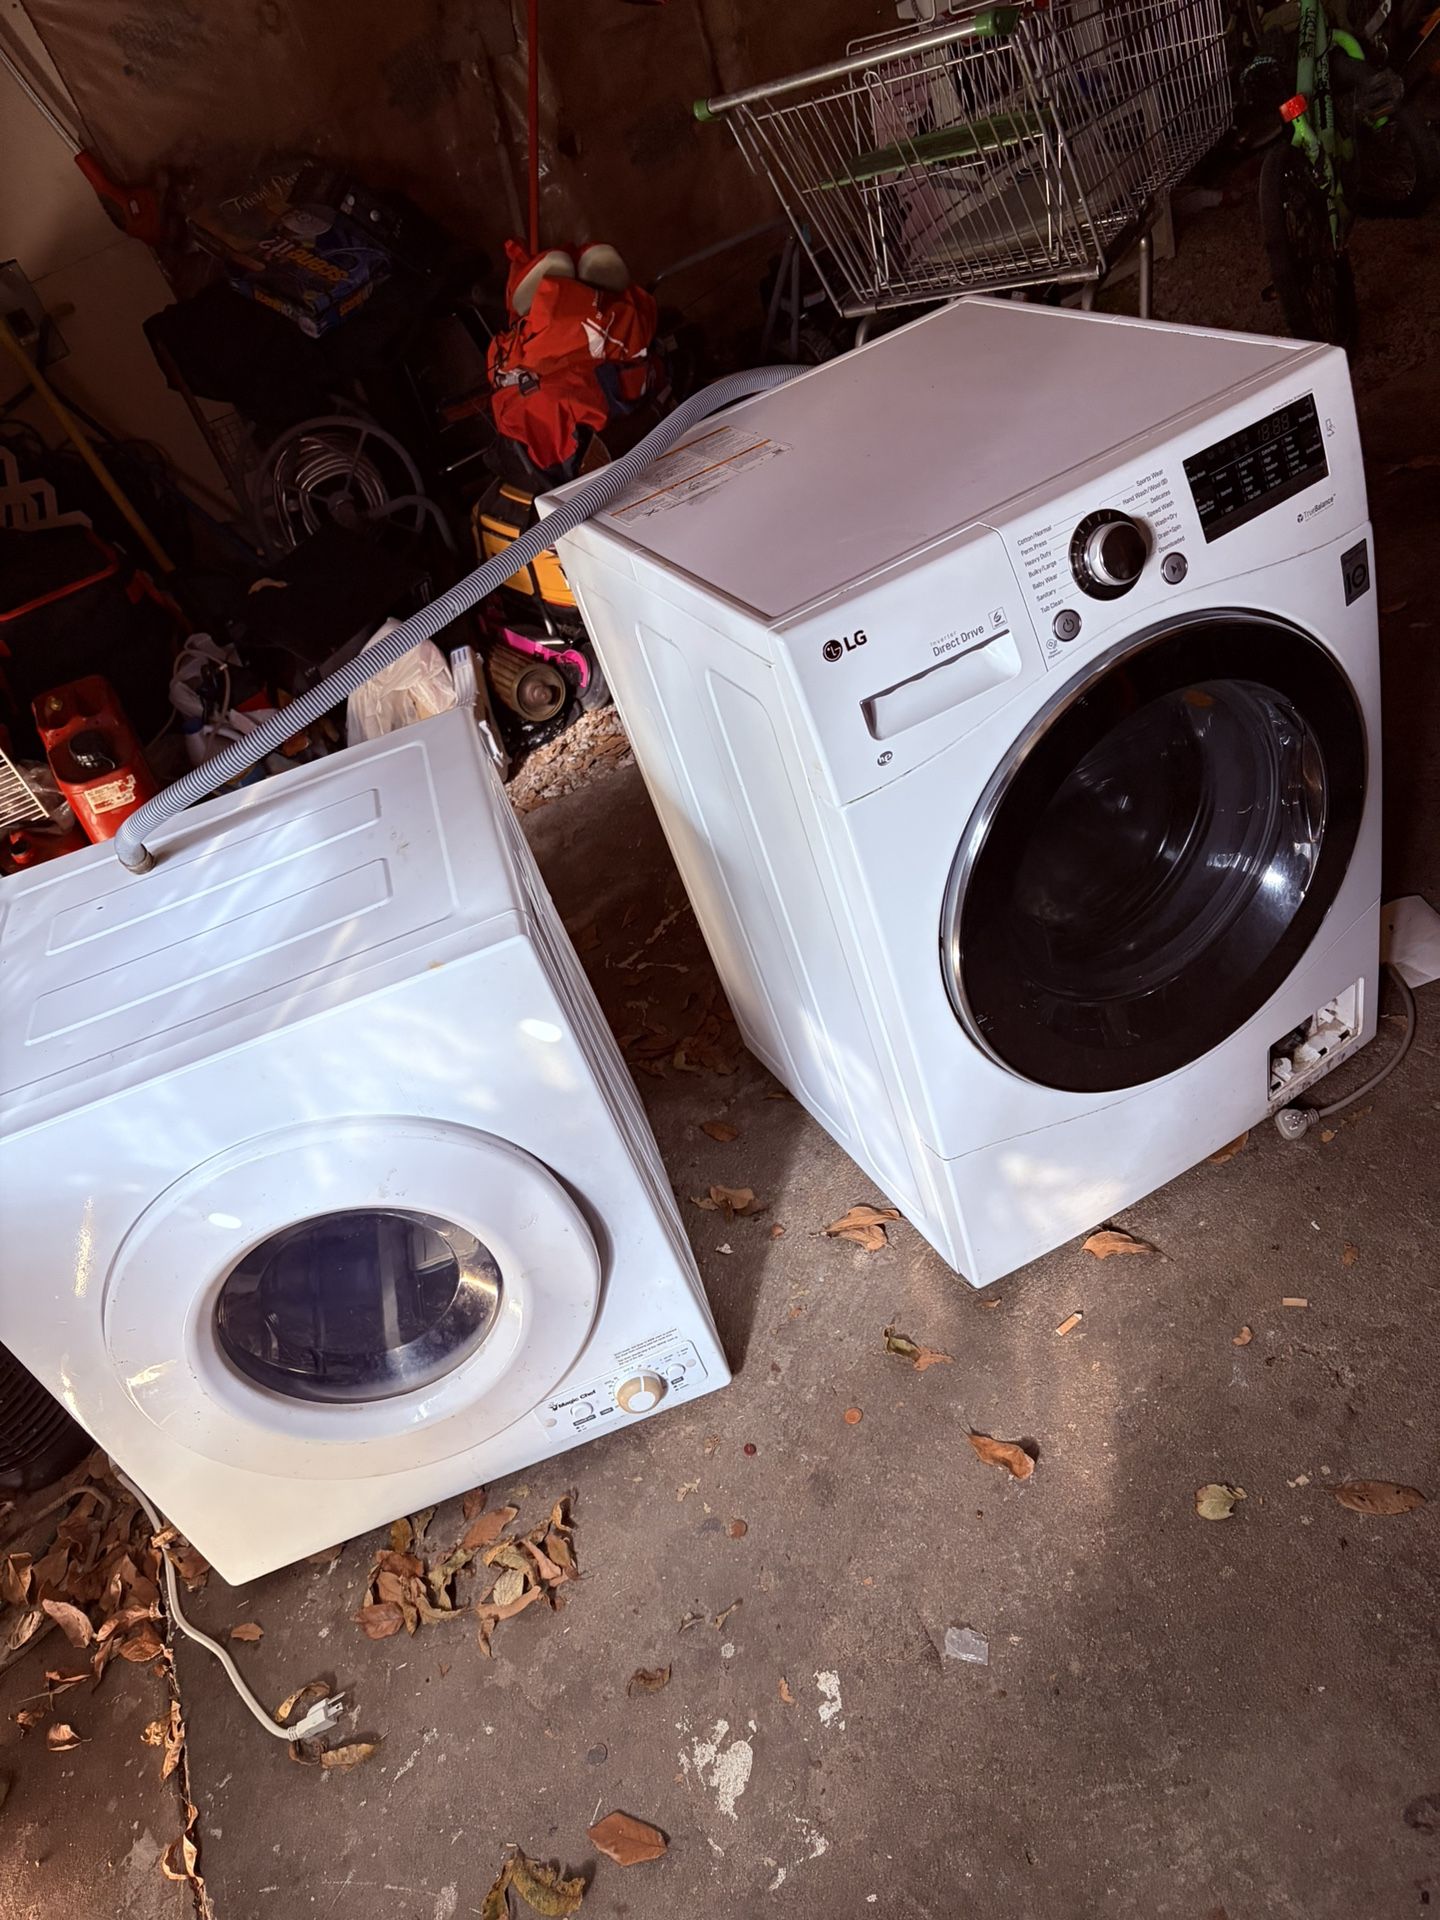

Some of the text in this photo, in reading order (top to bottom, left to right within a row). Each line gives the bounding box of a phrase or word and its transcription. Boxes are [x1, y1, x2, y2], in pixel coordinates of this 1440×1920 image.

[1136, 469, 1164, 488] Sports Wear
[1123, 495, 1135, 505] Hand
[1150, 489, 1171, 504] Delicates
[1146, 500, 1175, 518] Speed Wash
[1017, 526, 1052, 546] Cotton/Normal
[1021, 540, 1048, 556] Perm Press
[1024, 550, 1052, 567] Heavy Duty
[1028, 560, 1057, 579] Bulky/Large
[1032, 574, 1058, 591] Baby Wear
[1036, 588, 1057, 602] Sanitary
[1040, 599, 1064, 614] Tub Clean
[843, 629, 868, 652] LG
[932, 624, 985, 657] Direct Drive
[558, 1389, 596, 1409] Magic Chef
